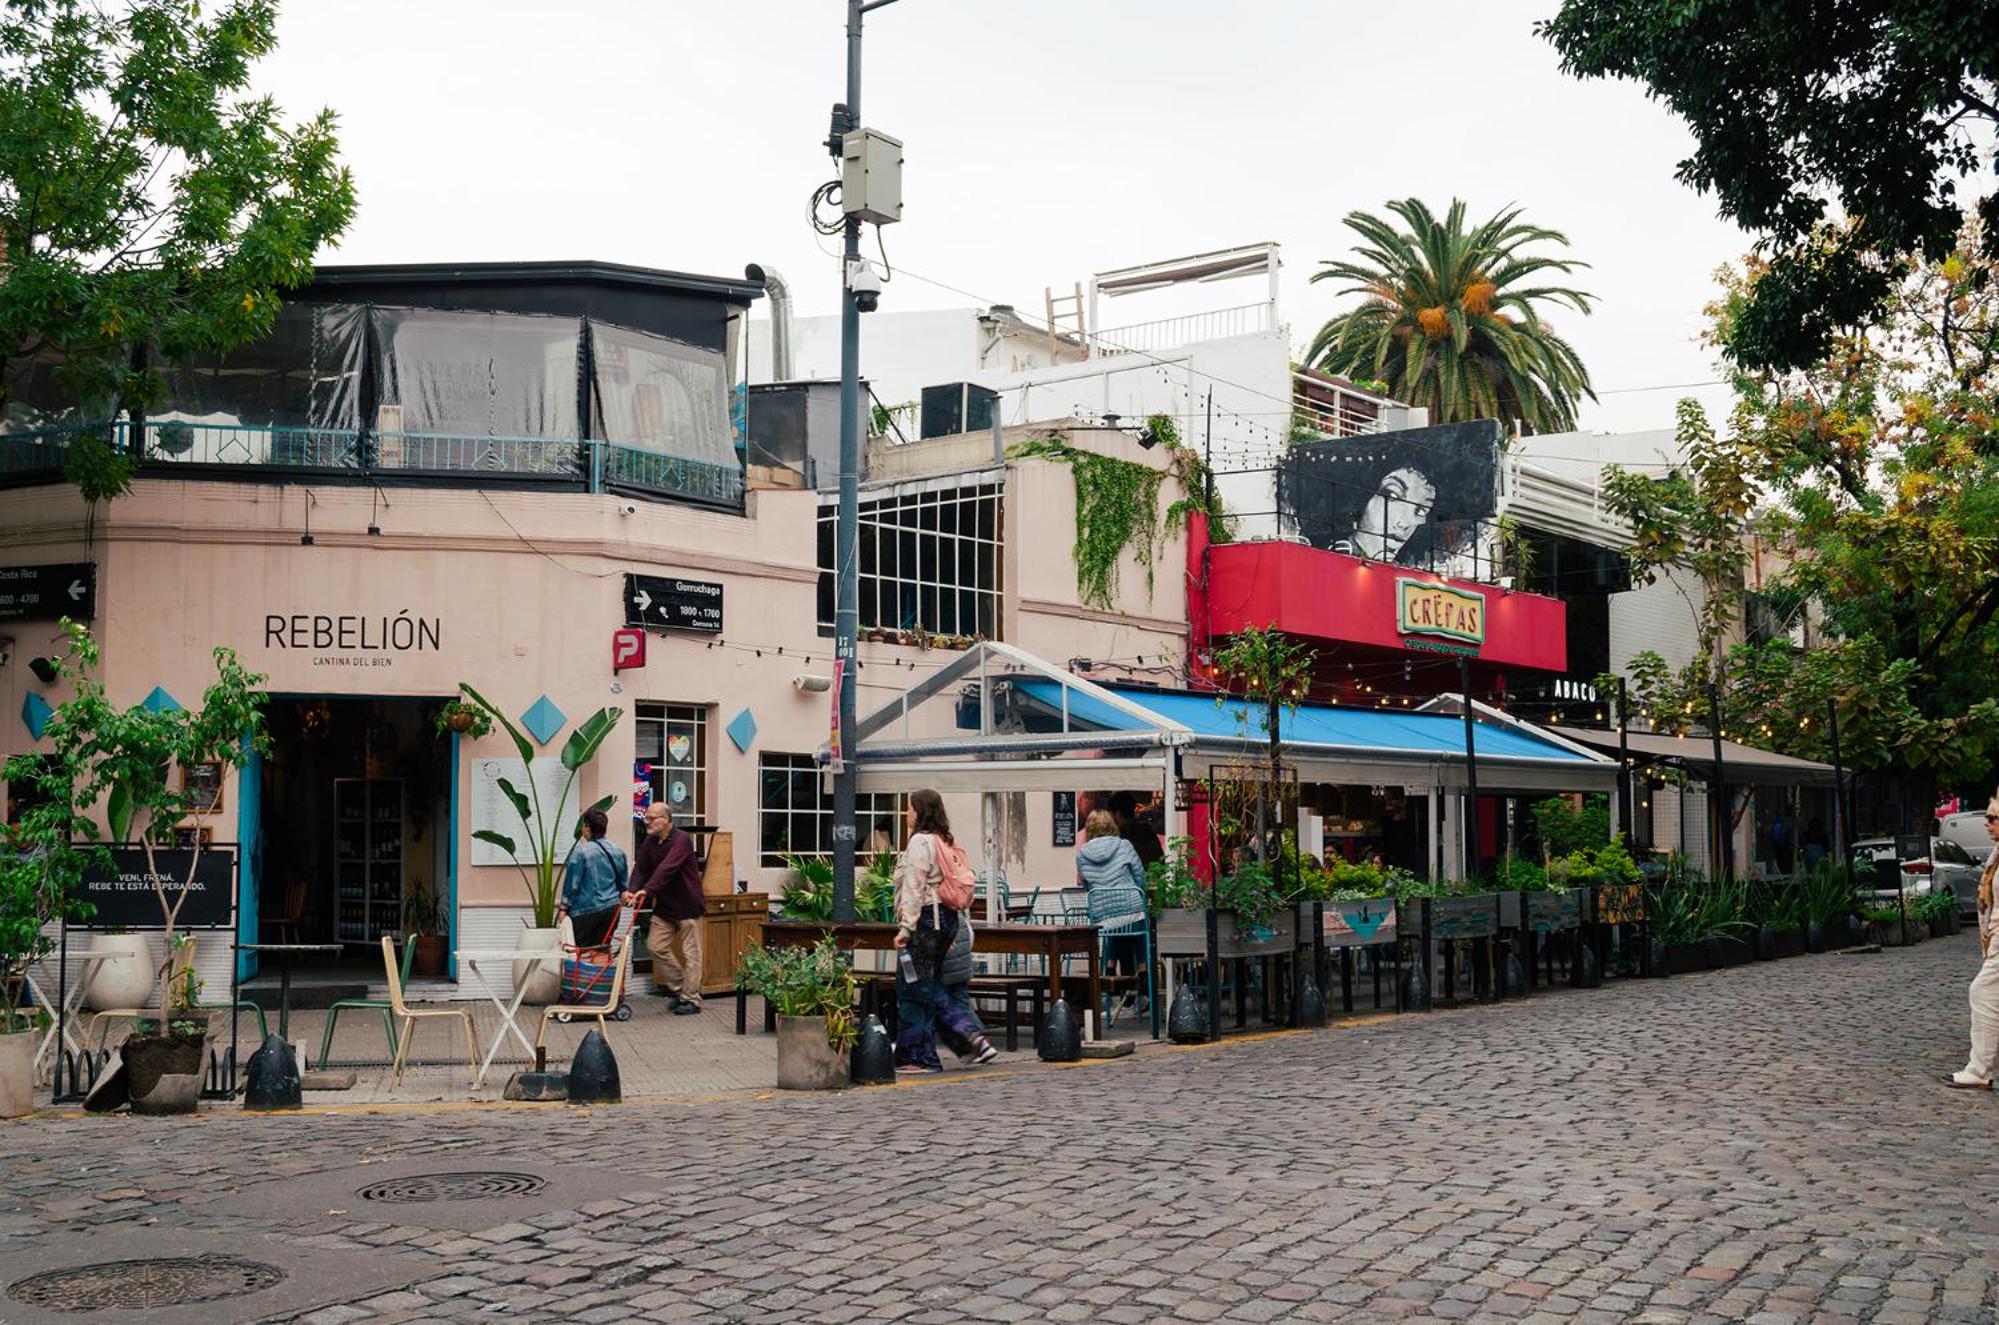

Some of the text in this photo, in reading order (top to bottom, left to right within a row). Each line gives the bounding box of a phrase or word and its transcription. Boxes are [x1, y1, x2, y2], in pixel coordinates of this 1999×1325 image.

[676, 581, 720, 596] Gurruchaga
[680, 605, 698, 616] 1800
[703, 608, 720, 618] 1700
[265, 608, 440, 651] REBELIÓN
[617, 634, 639, 664] P
[312, 656, 393, 667] CANTINA DEL BIEN
[1554, 679, 1597, 703] ABACO
[88, 880, 206, 891] REBE TE ESTÁ EPERADO.
